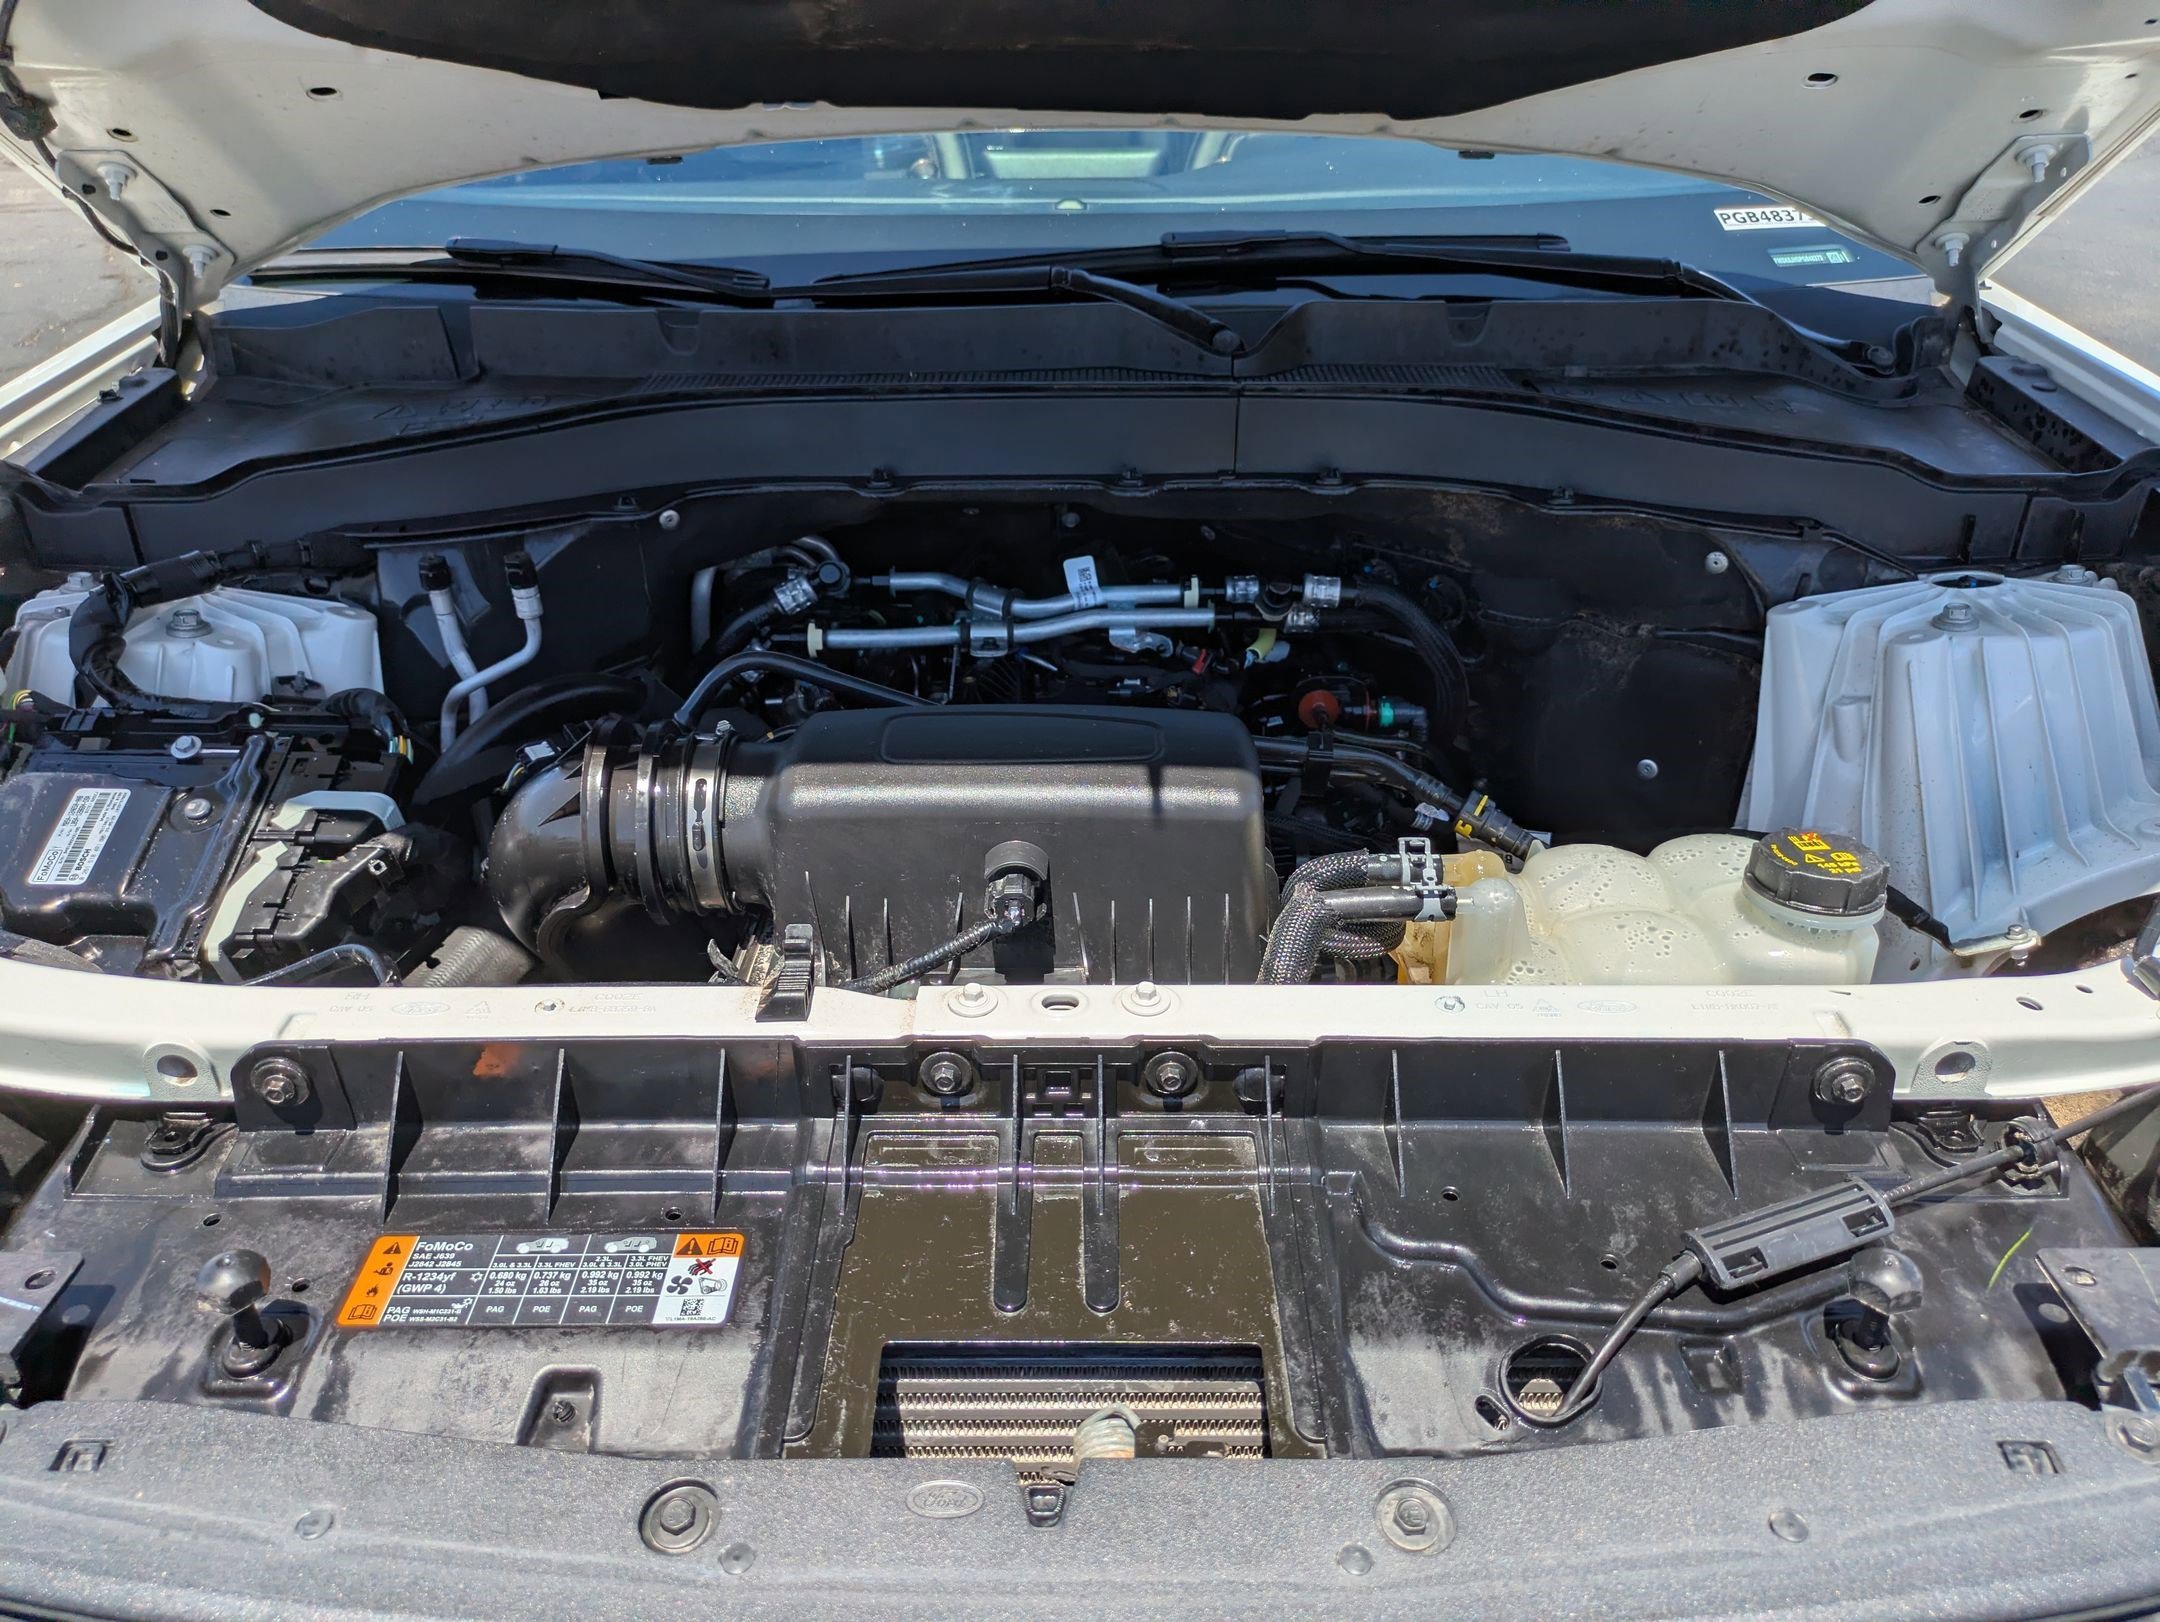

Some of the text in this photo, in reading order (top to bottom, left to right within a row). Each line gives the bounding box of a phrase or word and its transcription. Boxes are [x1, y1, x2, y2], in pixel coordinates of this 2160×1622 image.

[1719, 209, 1815, 224] PGB4837
[75, 848, 92, 871] BOSCH
[37, 850, 60, 880] FoMoCo
[415, 1241, 474, 1251] FoMoCo
[402, 1272, 457, 1283] R-1234yf
[489, 1271, 527, 1281] 0.680 kg
[533, 1271, 571, 1281] 0.737 kg
[582, 1271, 619, 1280] 0.992 kg
[626, 1271, 664, 1280] 0.992 kg
[397, 1284, 447, 1294] (GWP 4)
[387, 1306, 411, 1314] PAG
[383, 1314, 408, 1322] POE
[924, 1490, 968, 1507] Ford
